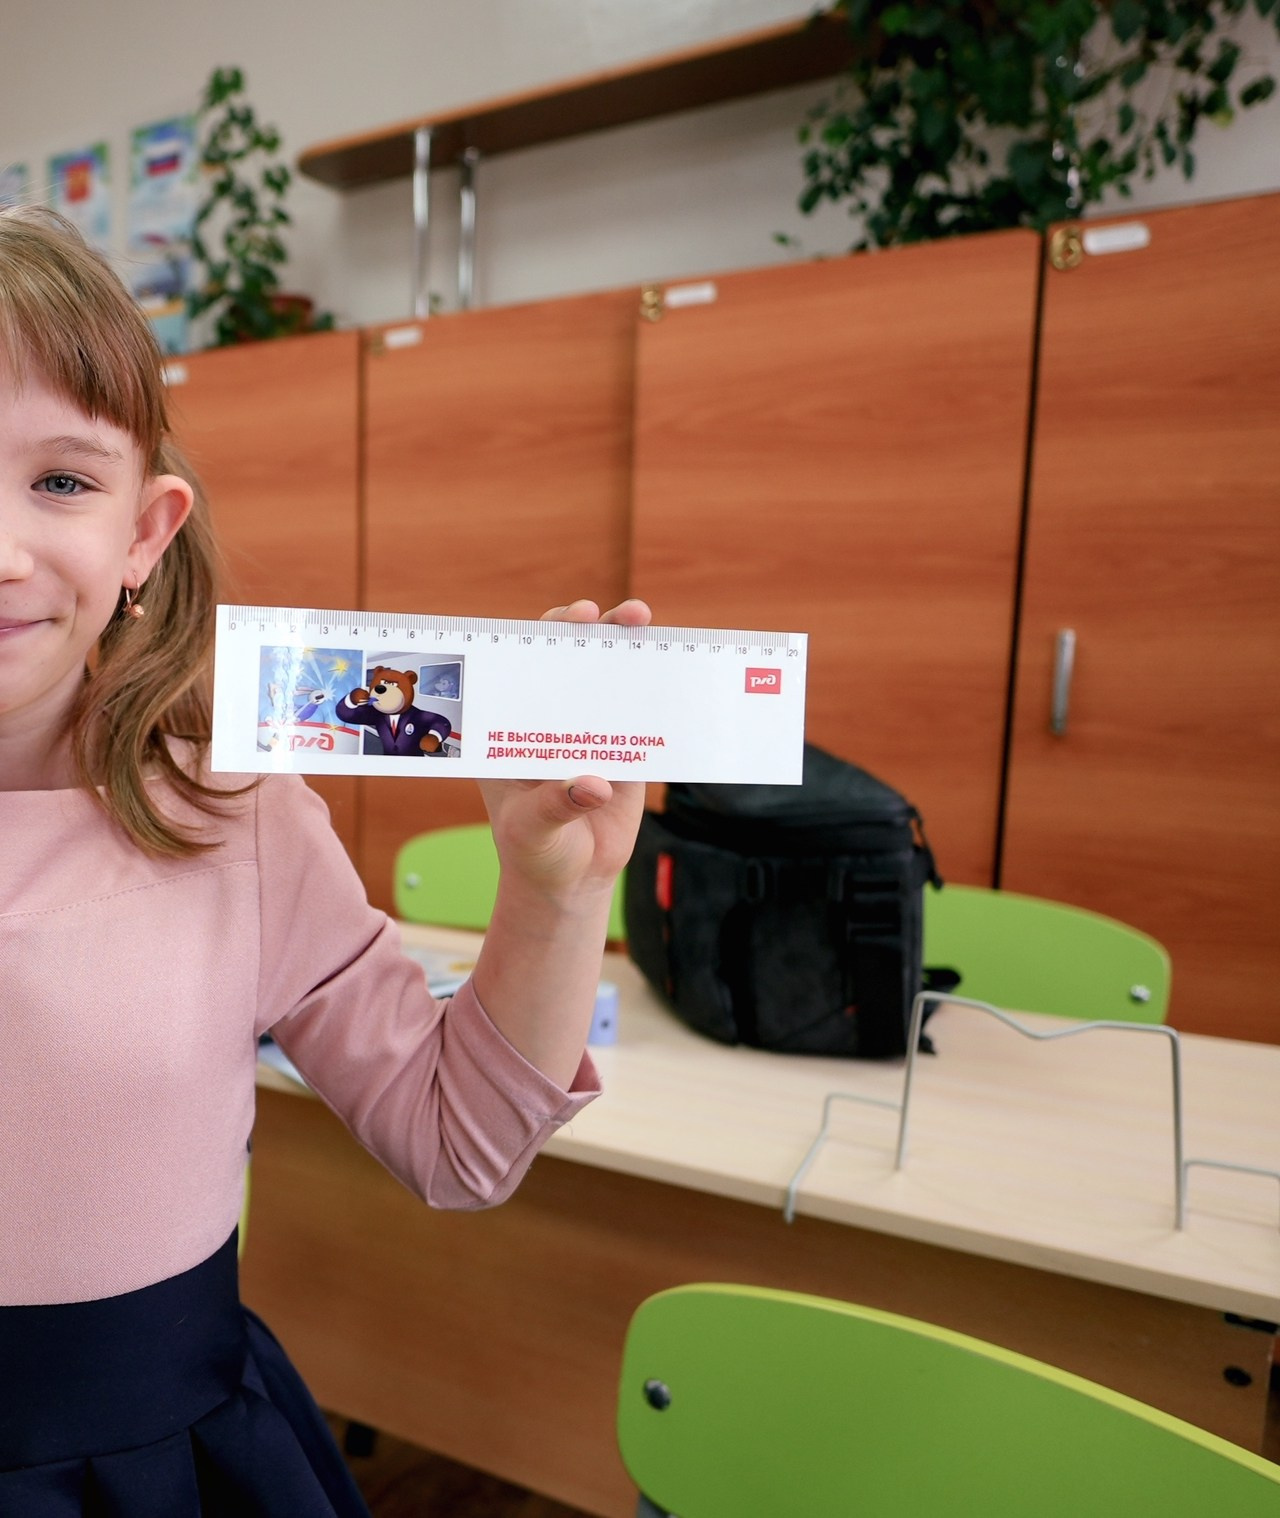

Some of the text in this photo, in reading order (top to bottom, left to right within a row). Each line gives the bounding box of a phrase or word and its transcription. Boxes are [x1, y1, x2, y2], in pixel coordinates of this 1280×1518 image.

[230, 622, 237, 630] 0
[260, 623, 265, 632] 1
[323, 625, 329, 635] 3
[352, 627, 359, 636] 4
[381, 629, 388, 638] 5
[409, 630, 416, 640] 6
[438, 631, 444, 641] 7
[466, 633, 473, 643] 8
[493, 634, 499, 644] 9
[522, 636, 532, 645] 10
[548, 637, 557, 646] 11
[576, 638, 586, 648] 12
[603, 640, 614, 649] 13
[632, 641, 641, 650] 14
[659, 642, 669, 651] 15
[686, 643, 696, 653] 16
[713, 644, 722, 653] 17
[738, 645, 748, 655] 18
[764, 647, 773, 656] 19
[788, 648, 799, 657] 20
[487, 731, 666, 747] НЕ ВЫСОВЫВАЙСЯ ИЗ ОКНА
[486, 746, 647, 763] ДВИЖУЩЕГОСЯ ПОЕЗДА!
